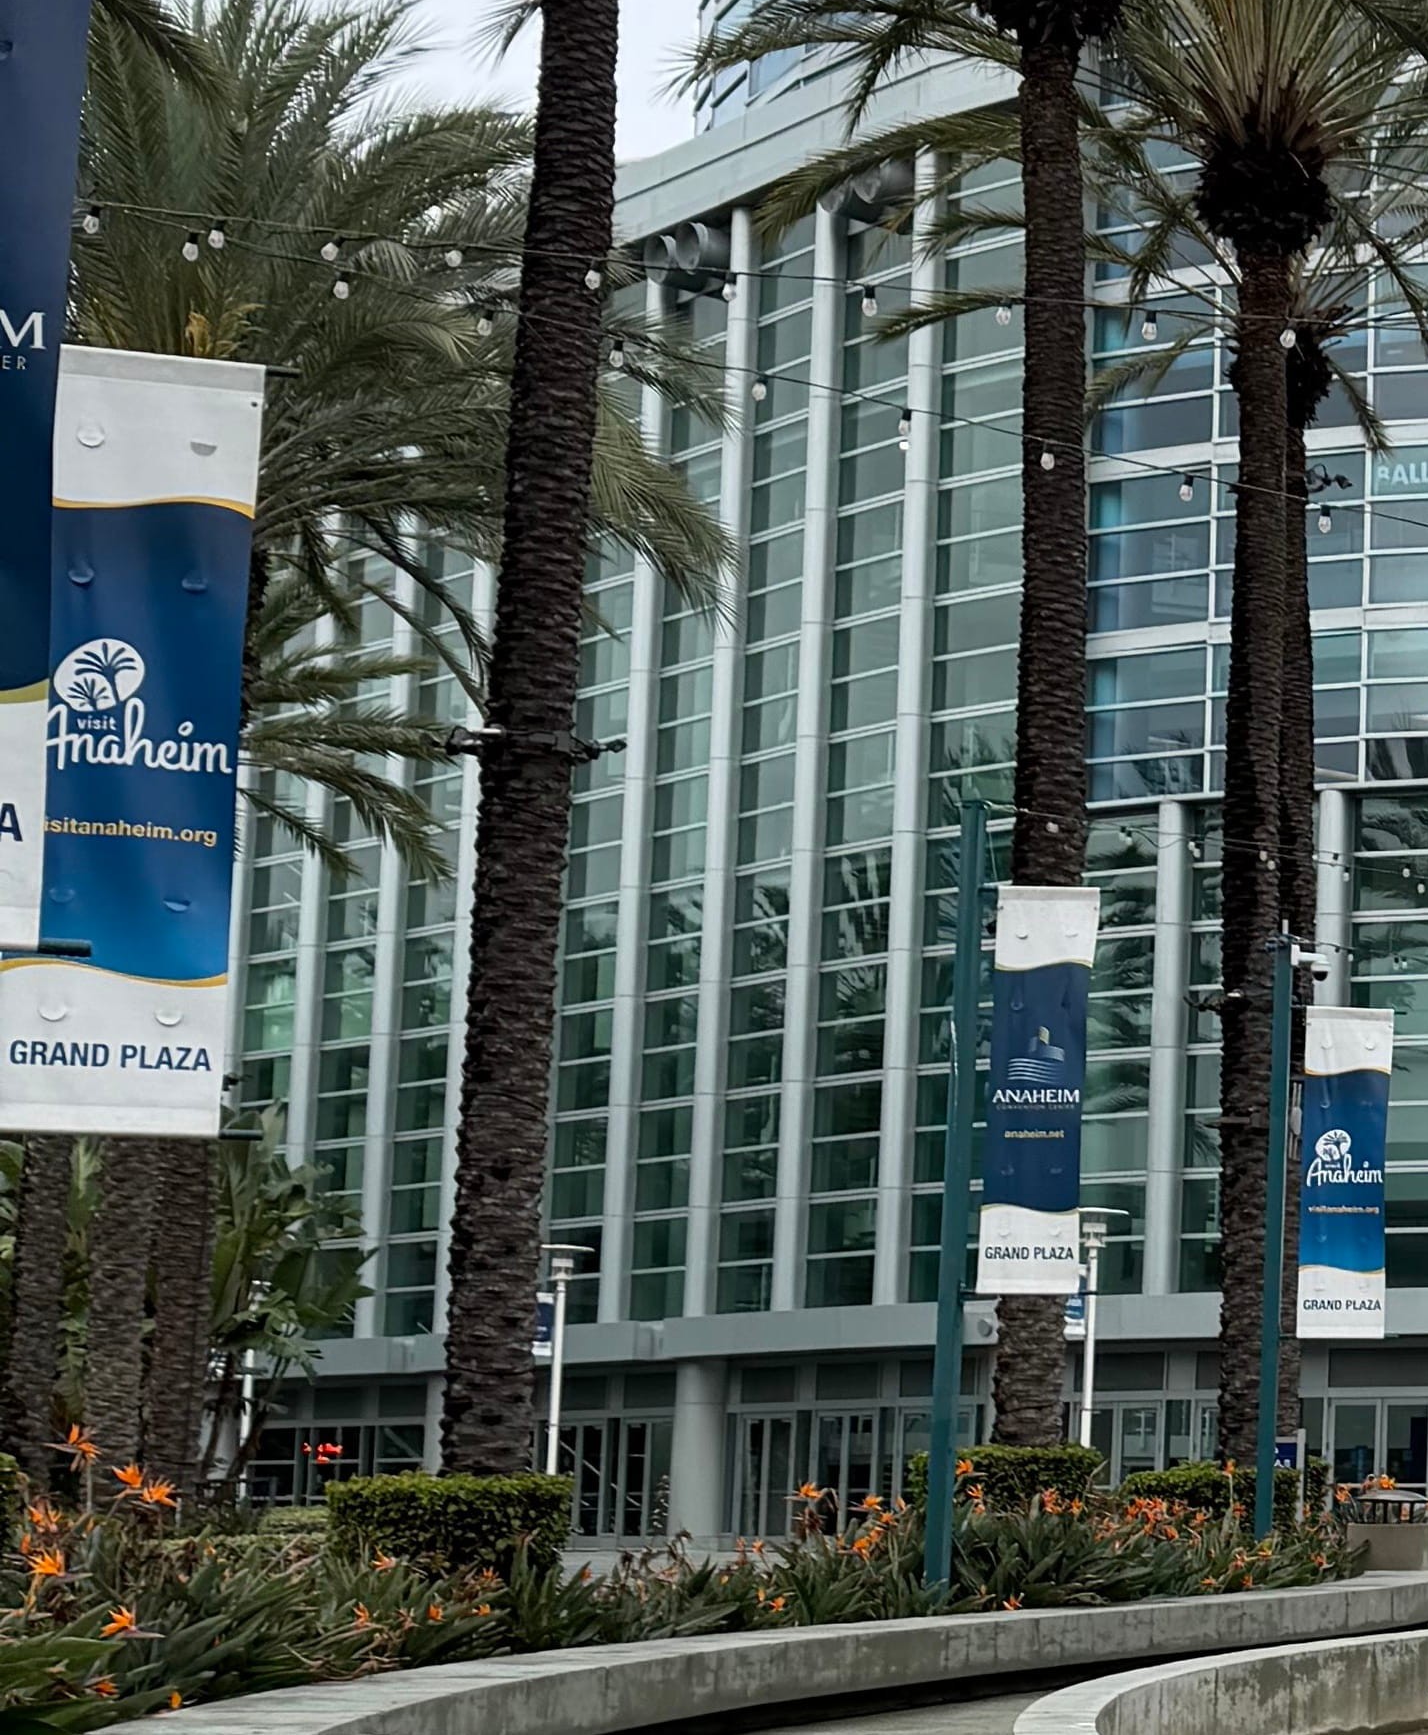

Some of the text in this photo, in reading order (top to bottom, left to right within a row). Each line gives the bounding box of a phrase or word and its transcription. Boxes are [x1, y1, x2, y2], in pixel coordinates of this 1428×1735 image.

[77, 715, 118, 731] visit
[47, 697, 233, 775] Anaheim
[44, 814, 218, 848] isitanaheim.org
[9, 1039, 212, 1072] GRAND PLAZA
[992, 1089, 1080, 1104] ANAHEIM
[1306, 1154, 1383, 1186] Anaheim
[984, 1246, 1074, 1260] GRAND PLAZA
[1303, 1299, 1381, 1311] GRAND PLAZA
